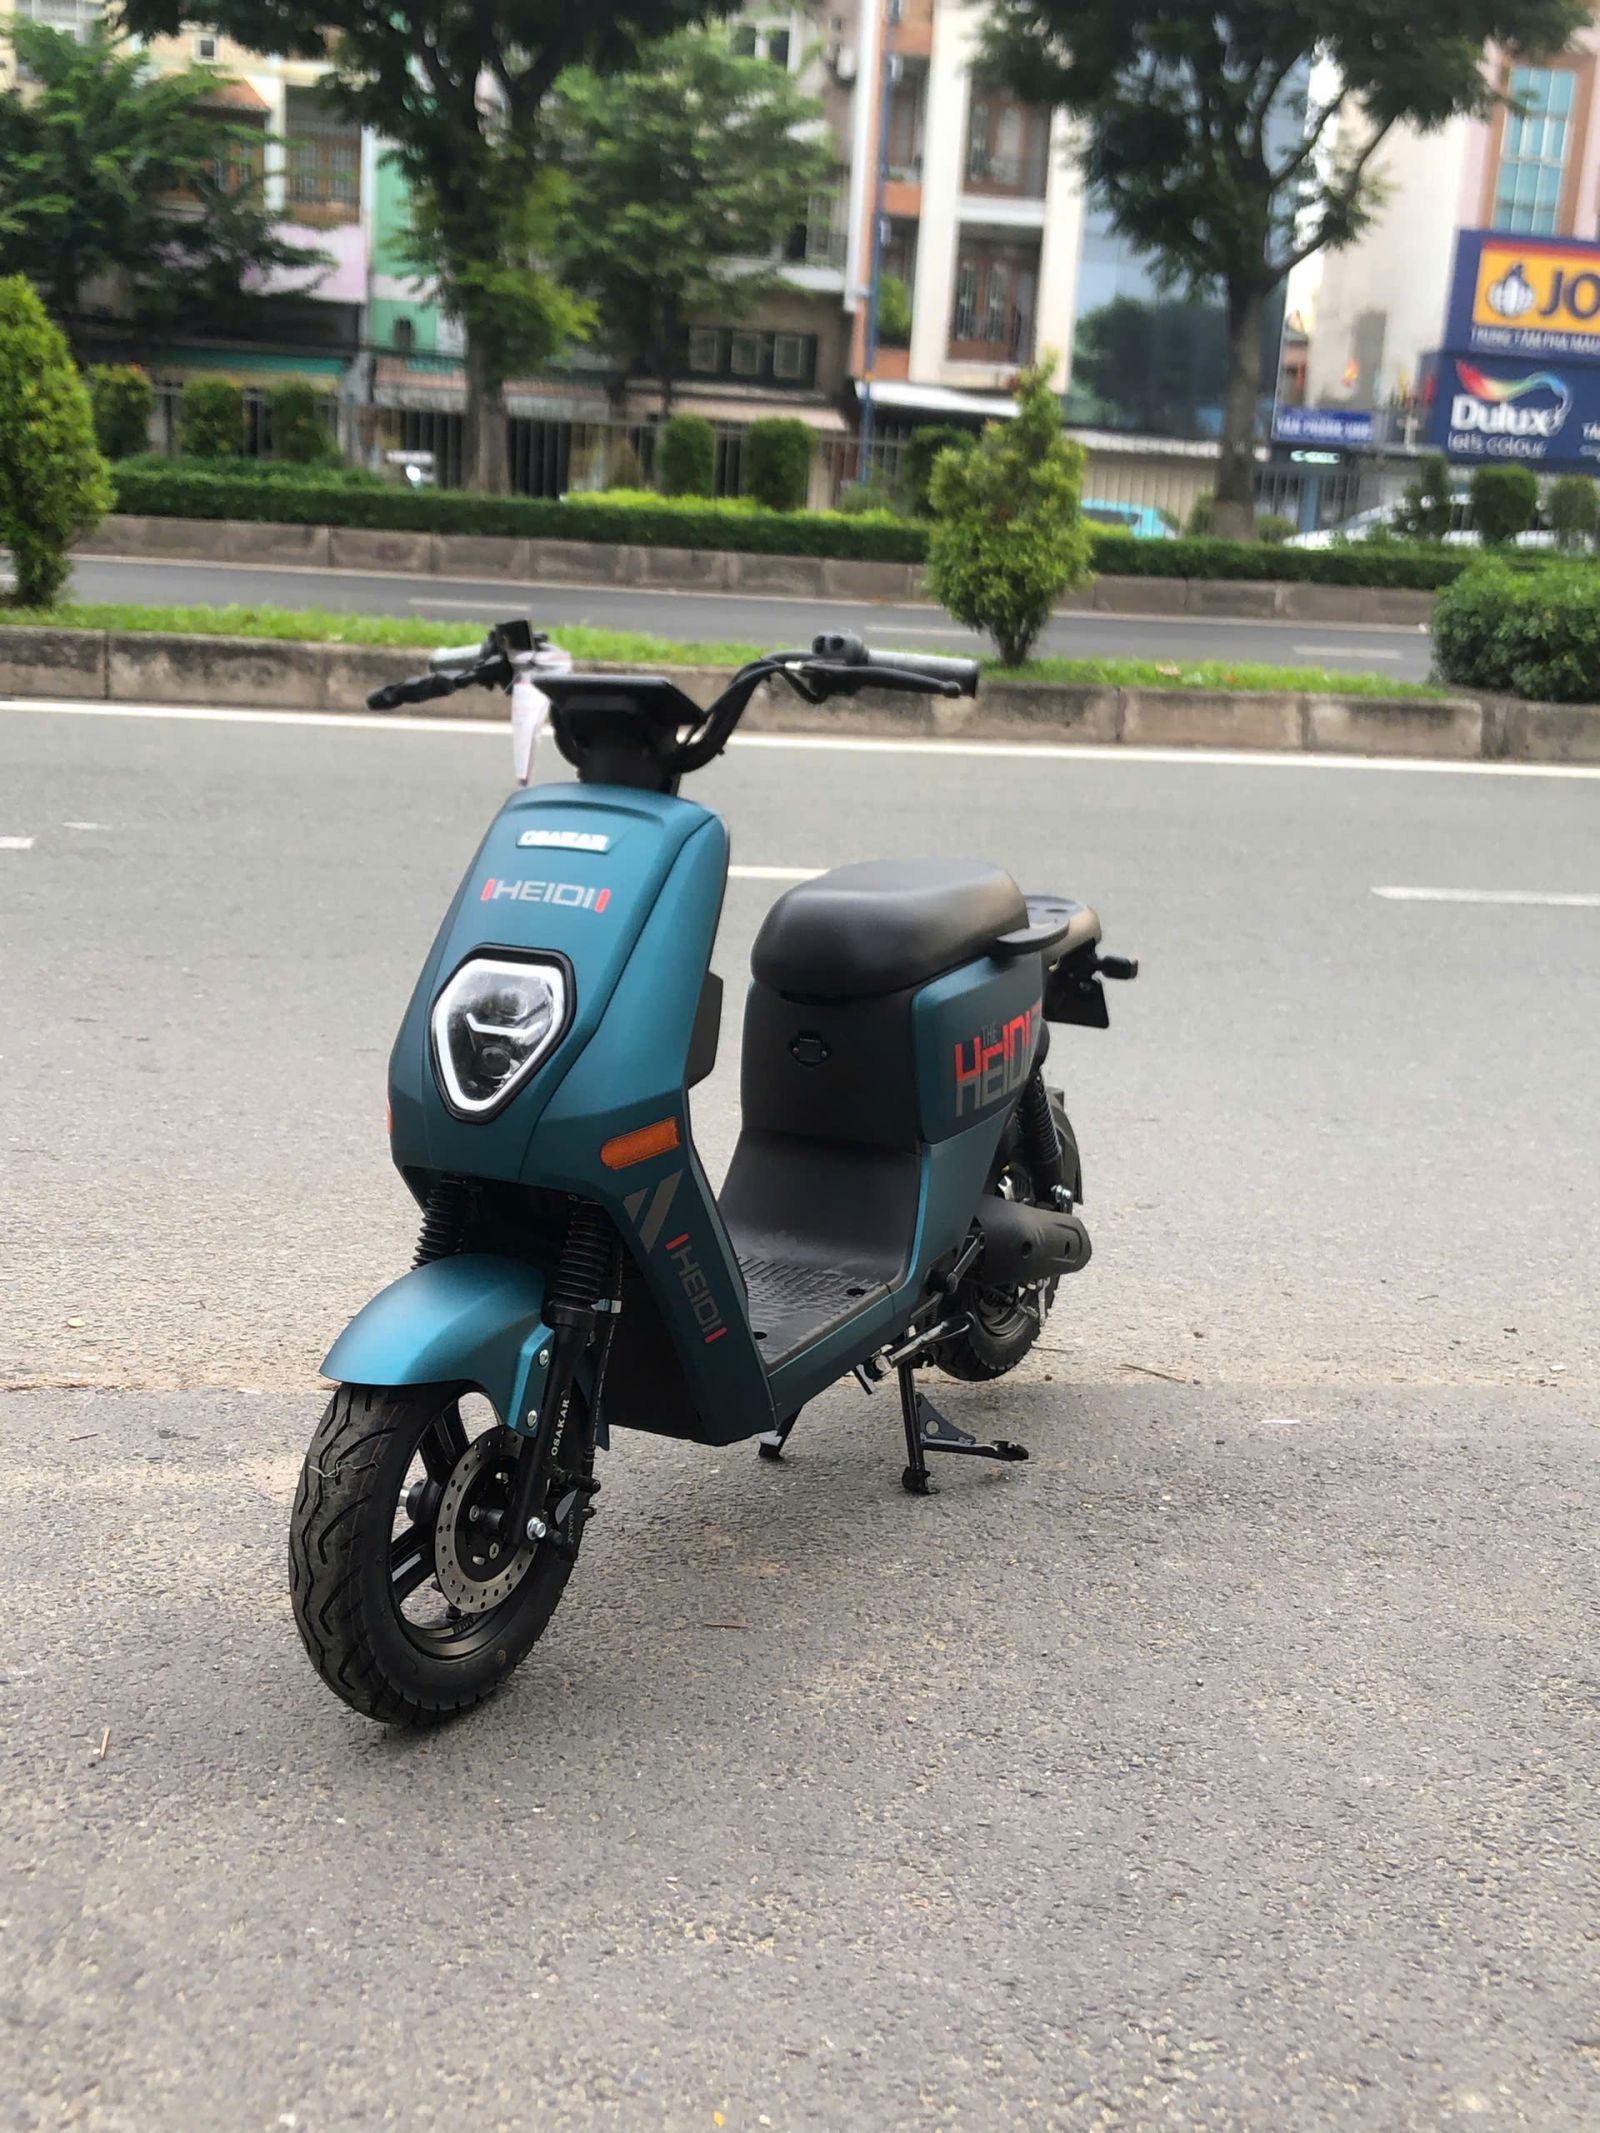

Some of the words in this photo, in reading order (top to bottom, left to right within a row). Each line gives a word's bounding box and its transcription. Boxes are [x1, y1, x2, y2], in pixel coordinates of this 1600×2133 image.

[1450, 394, 1556, 437] Dulux
[491, 879, 596, 909] HEIDI
[671, 1245, 722, 1333] HEIDI
[551, 1399, 570, 1456] OSAKAR
